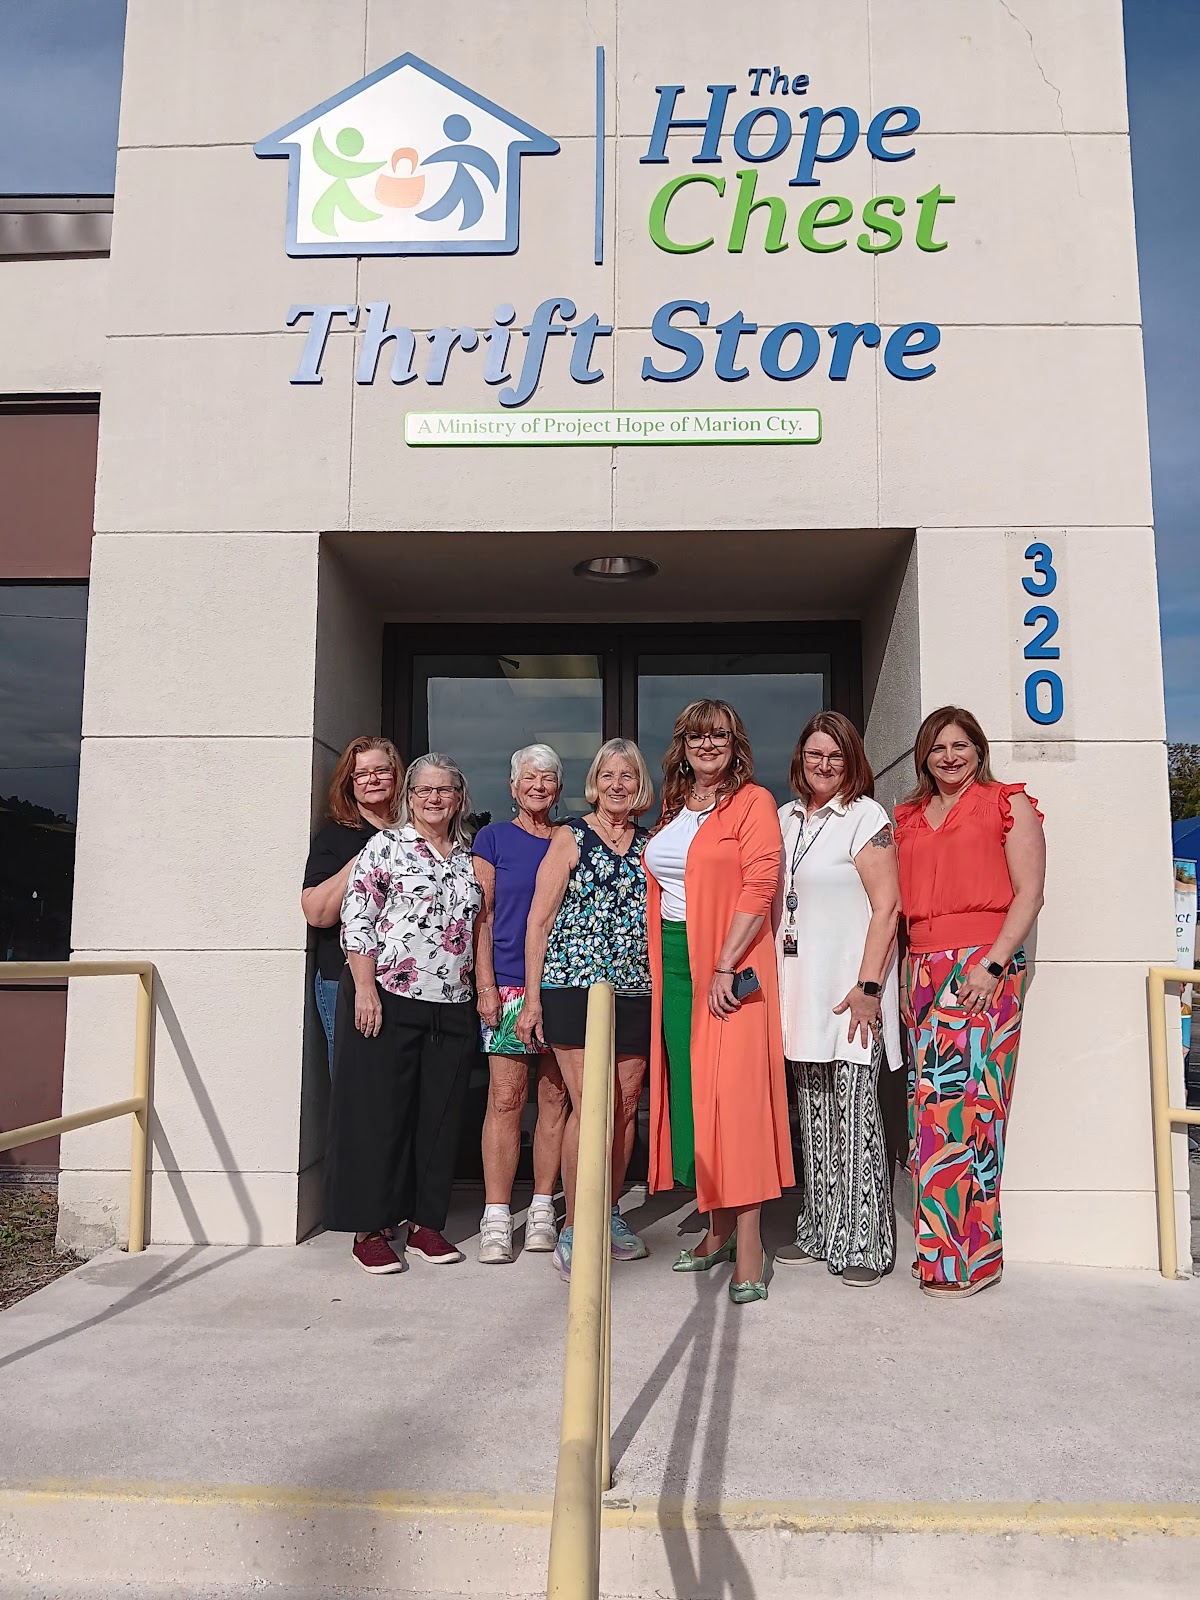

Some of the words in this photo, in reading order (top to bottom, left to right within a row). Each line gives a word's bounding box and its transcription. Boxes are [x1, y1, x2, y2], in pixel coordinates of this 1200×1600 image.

[748, 66, 809, 96] The
[639, 84, 921, 187] Hope
[648, 169, 956, 254] Chest
[286, 297, 613, 408] Thrift
[641, 299, 941, 382] Store
[417, 419, 433, 434] A
[437, 418, 516, 437] Ministry
[521, 418, 540, 433] of
[544, 417, 611, 436] Project
[616, 417, 665, 436] Hope
[670, 416, 690, 432] of
[694, 416, 761, 432] Marion
[766, 416, 802, 435] Cty.
[1021, 542, 1064, 726] 320
